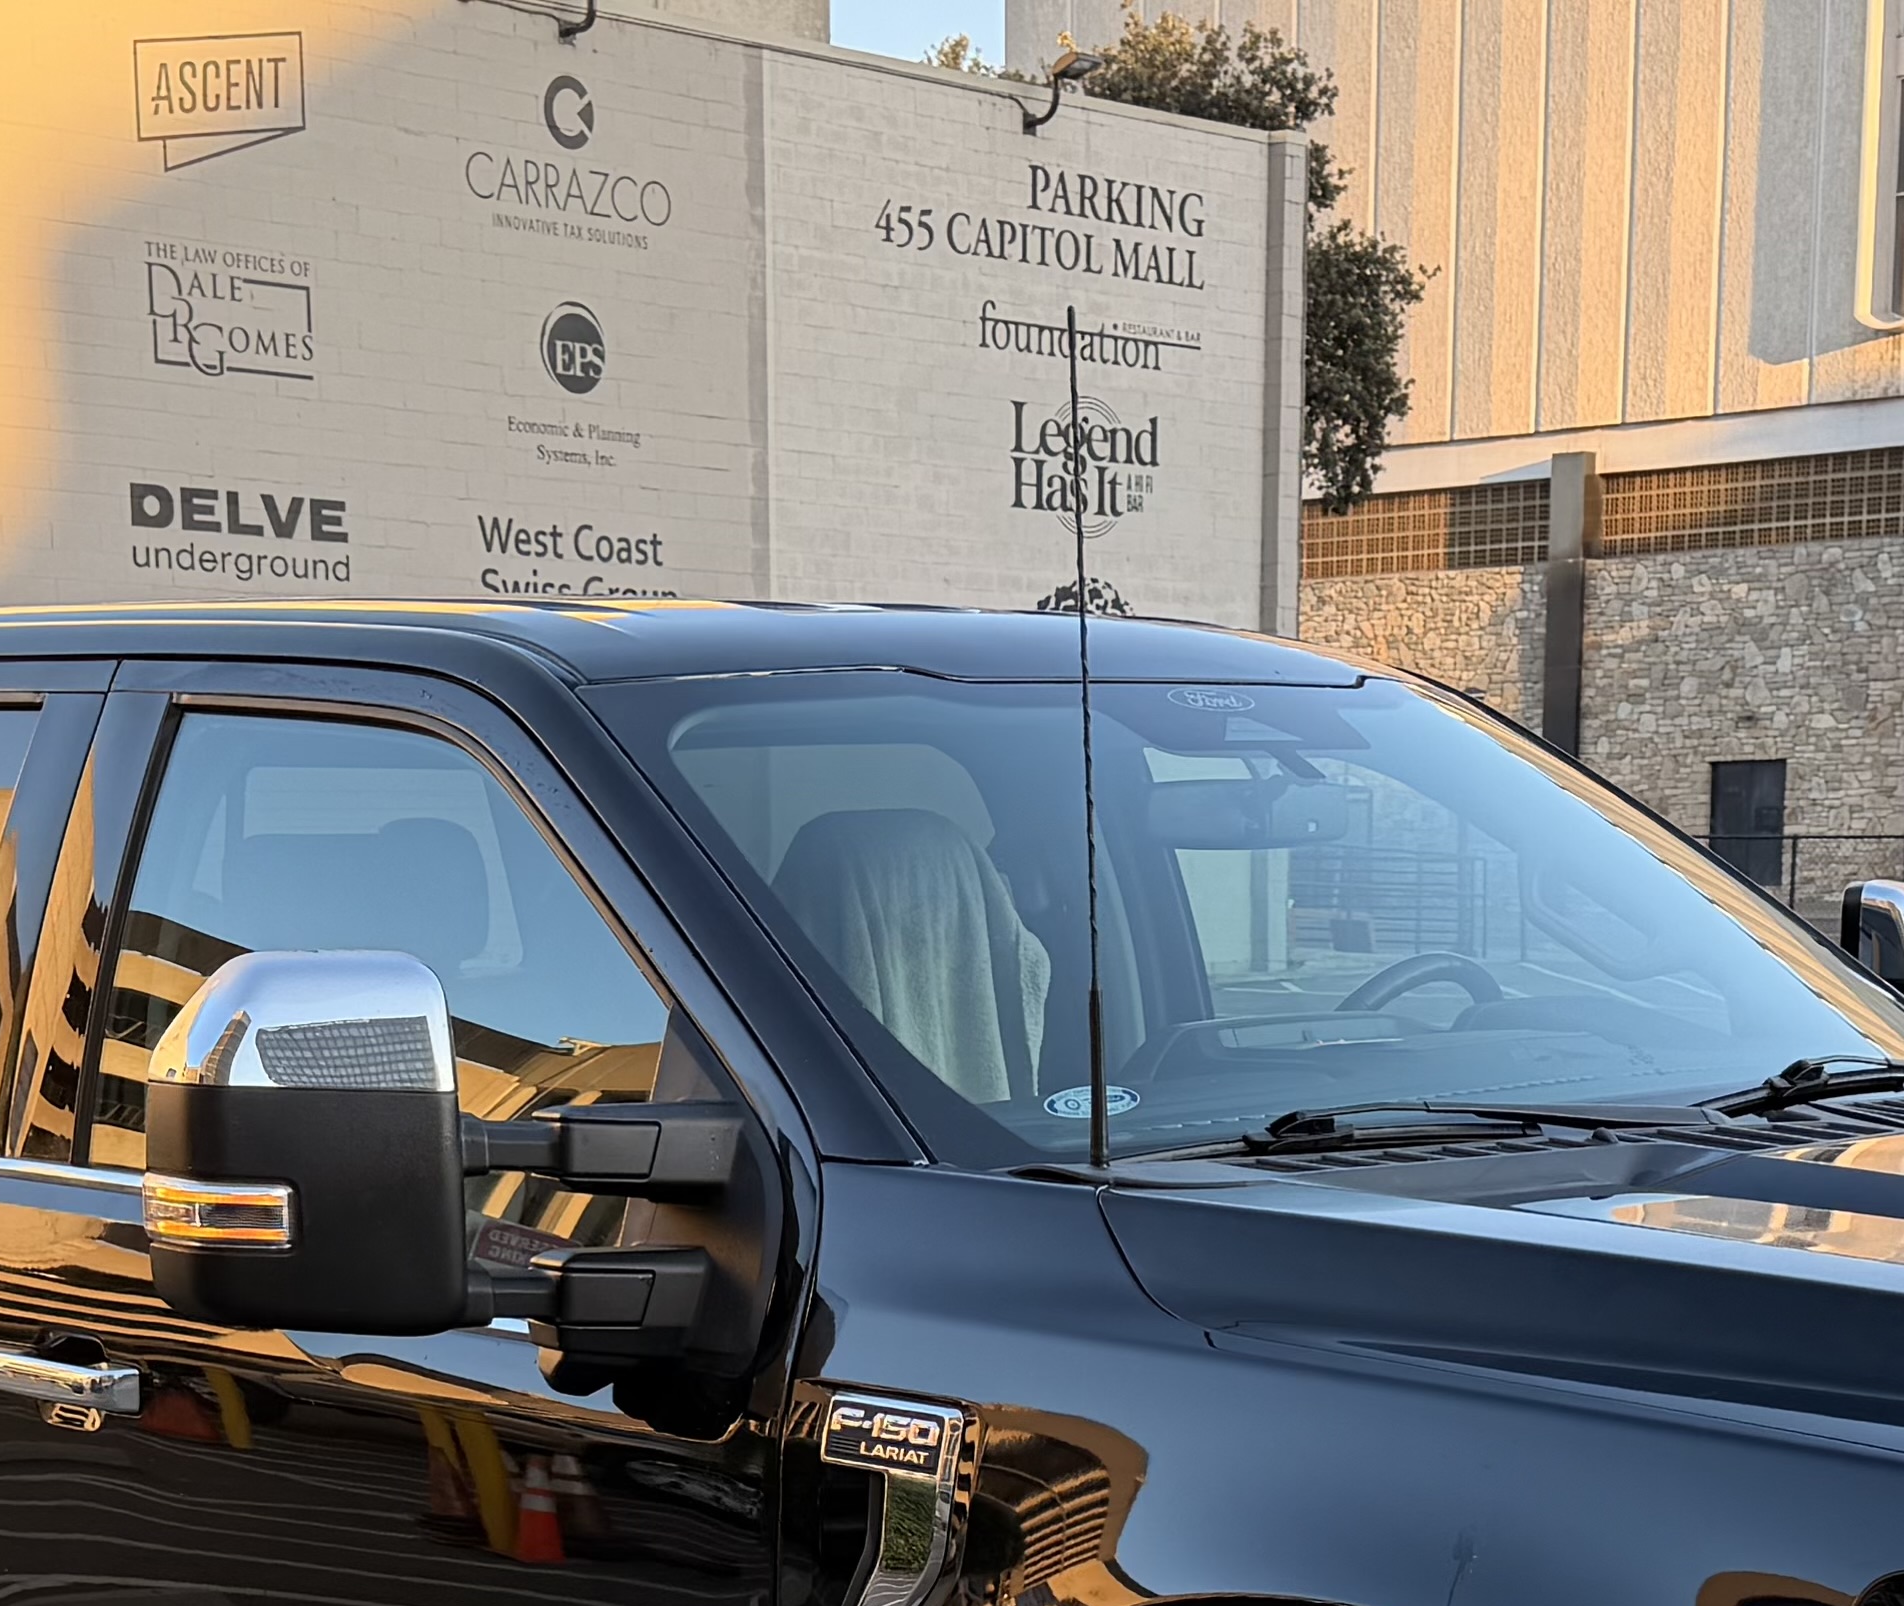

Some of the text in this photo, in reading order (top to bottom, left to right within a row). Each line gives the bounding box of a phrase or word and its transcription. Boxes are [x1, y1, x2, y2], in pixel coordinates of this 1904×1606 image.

[151, 57, 286, 115] ASCENT
[466, 151, 671, 226] CARRAZCO
[1026, 164, 1205, 237] PARKING
[492, 213, 648, 250] INNOVATIVE TAX SOLUTIONS
[875, 199, 1205, 290] 455 CAPITOL MALL
[145, 241, 311, 277] THE LAW OFFICES OF
[188, 322, 314, 377] GOMES
[554, 340, 605, 379] EPS
[507, 415, 641, 448] Economic & Planning
[1010, 400, 1160, 477] Legend
[537, 444, 617, 468] Systems, Inc.
[1010, 456, 1125, 518] Has It
[130, 483, 349, 543] DELVE
[132, 543, 350, 582] underground
[477, 514, 664, 567] West Coast
[1184, 690, 1243, 708] Ford
[831, 1407, 940, 1447] F-150
[859, 1441, 929, 1466] LARIAT
